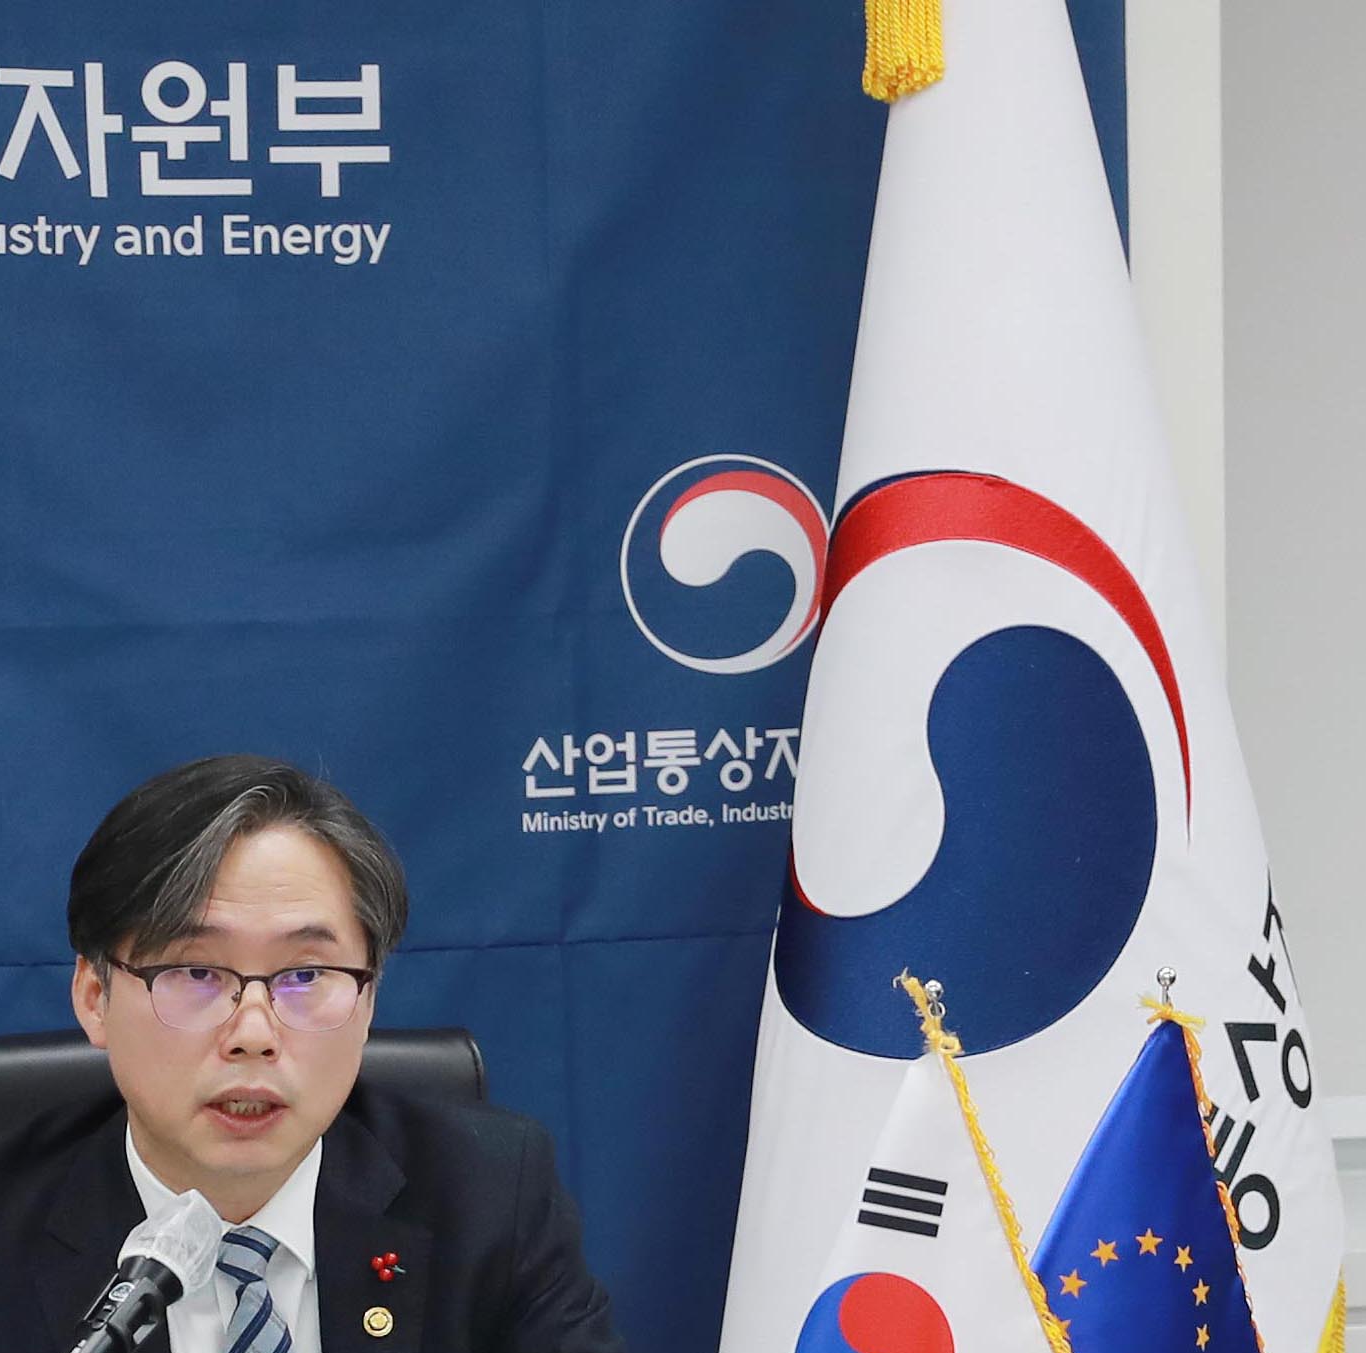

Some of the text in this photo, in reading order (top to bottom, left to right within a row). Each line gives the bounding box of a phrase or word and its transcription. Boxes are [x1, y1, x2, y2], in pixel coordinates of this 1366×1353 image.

[114, 214, 203, 256] and
[223, 214, 391, 265] Energy
[522, 808, 607, 833] Ministry
[613, 807, 636, 827] of
[643, 804, 714, 828] Trade,
